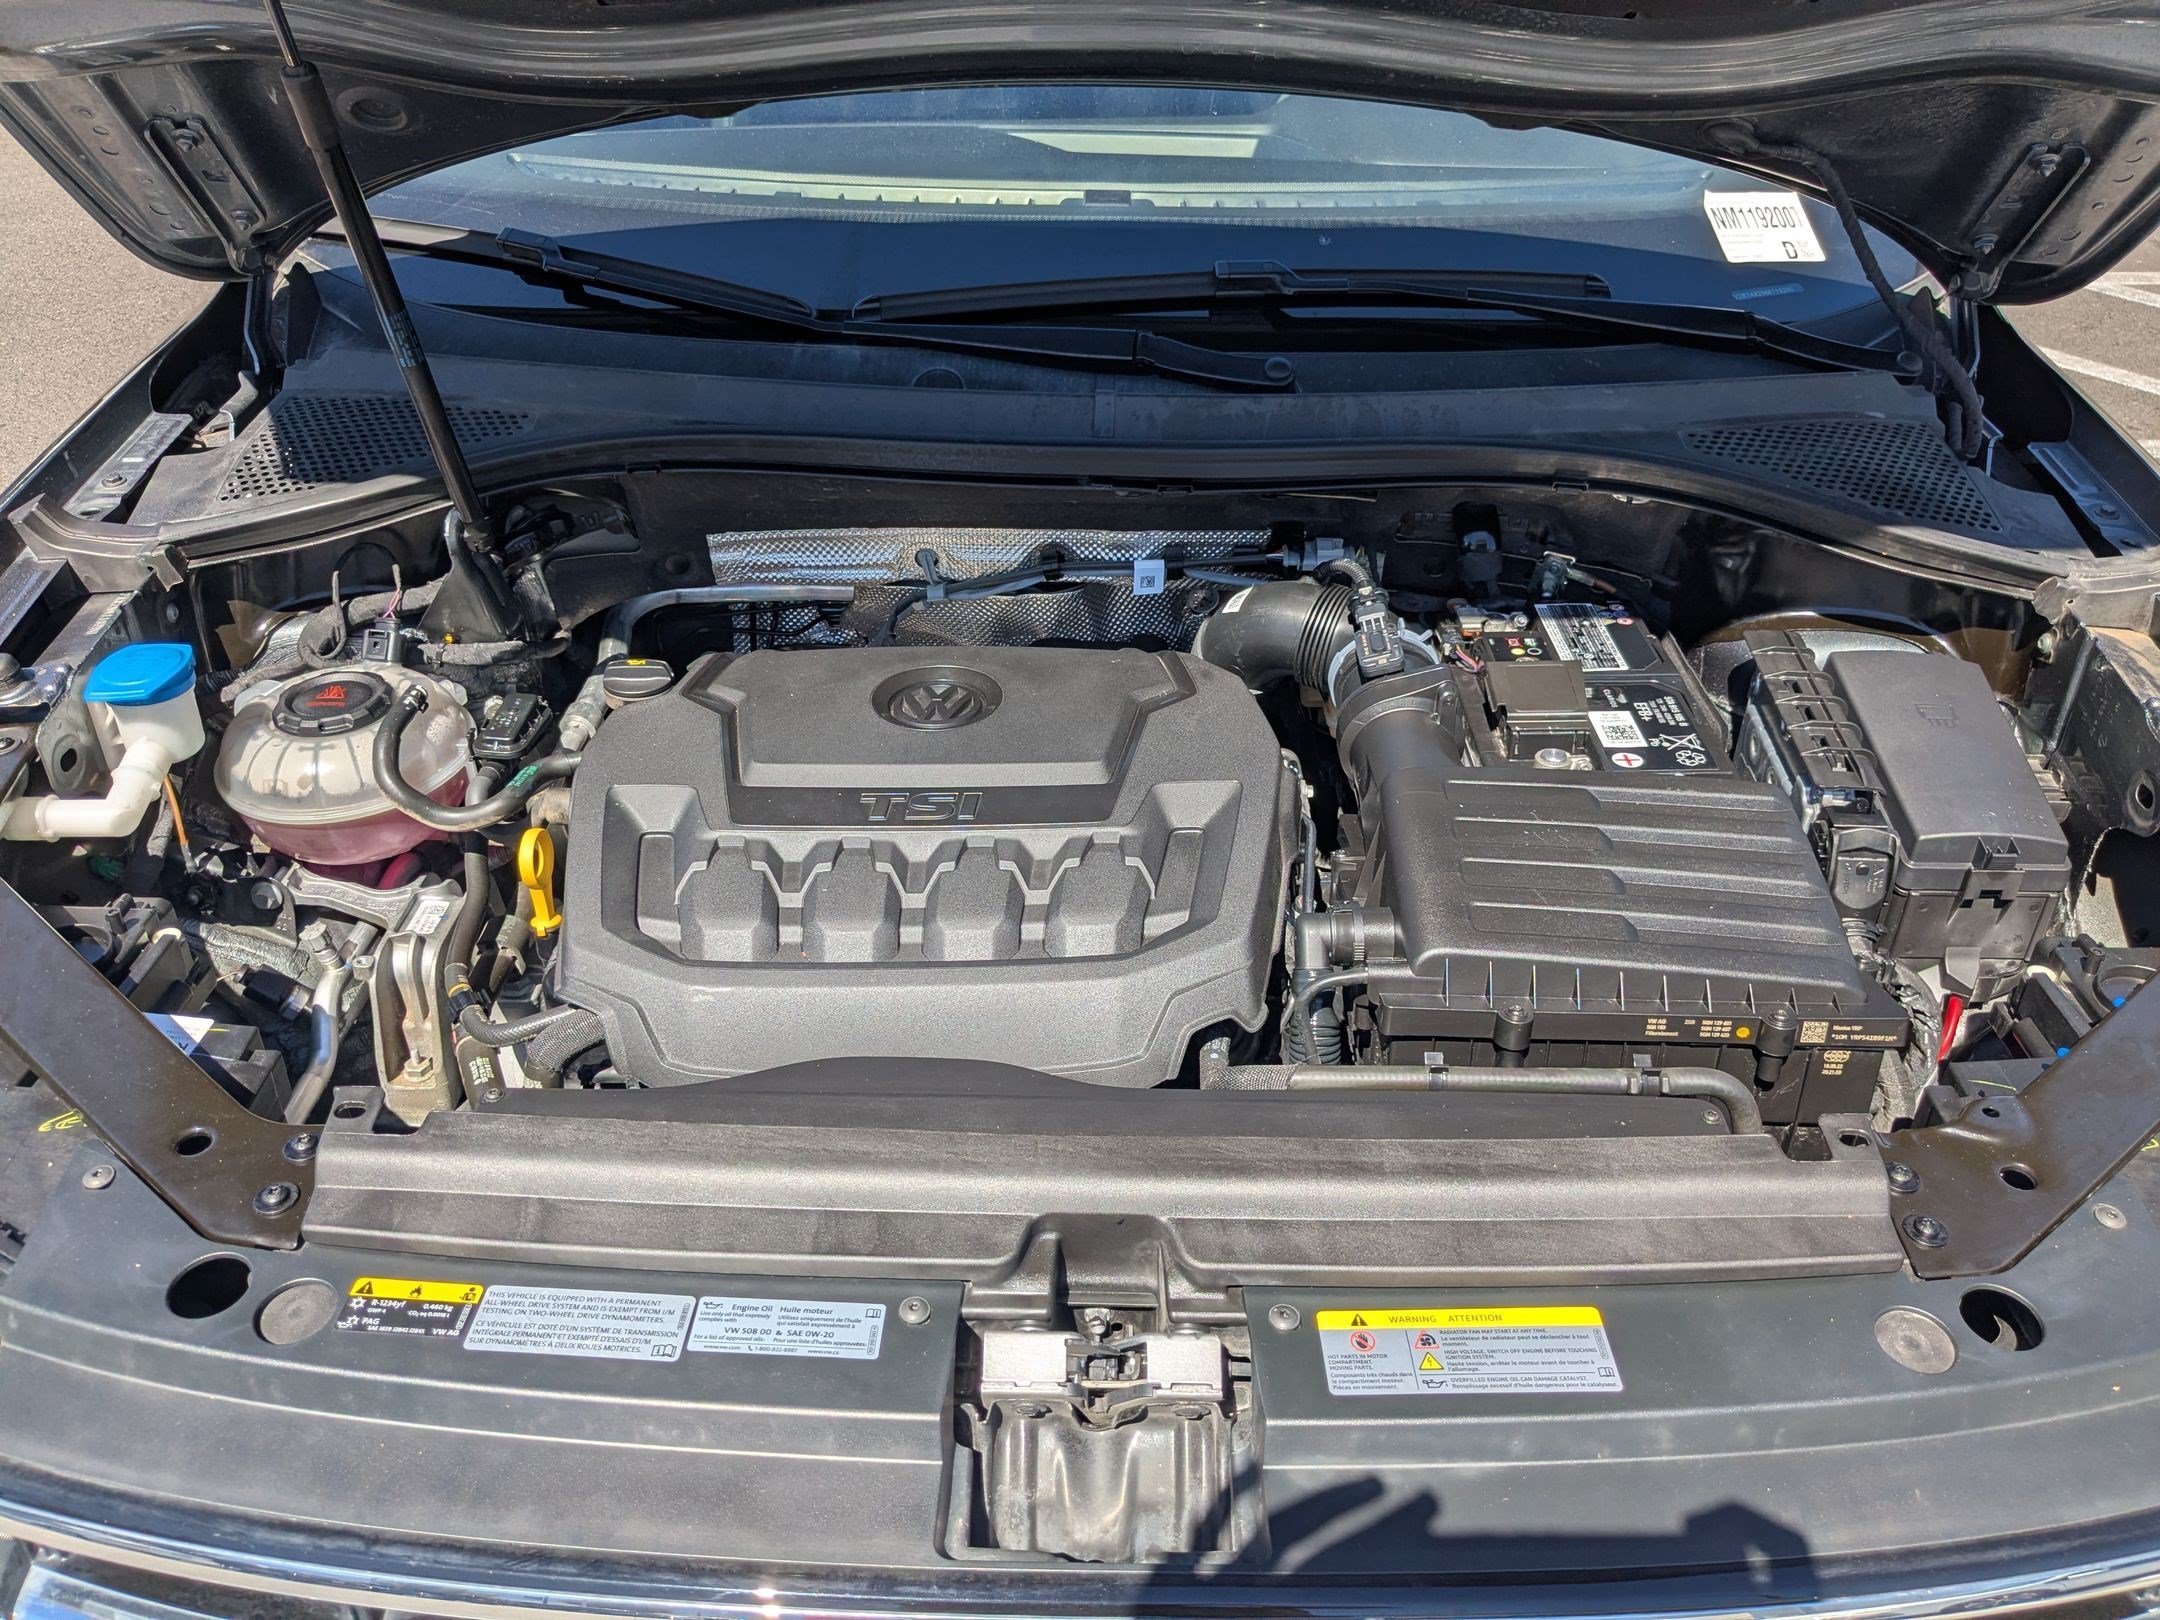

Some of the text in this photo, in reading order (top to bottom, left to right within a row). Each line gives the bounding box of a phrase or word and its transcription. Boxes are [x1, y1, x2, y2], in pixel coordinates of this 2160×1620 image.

[1782, 241, 1798, 259] D
[1633, 702, 1653, 722] EFB+
[860, 792, 983, 821] TSI
[732, 1304, 759, 1312] Engine
[1388, 1315, 1437, 1323] WARNING
[1448, 1314, 1502, 1322] ATTENTION
